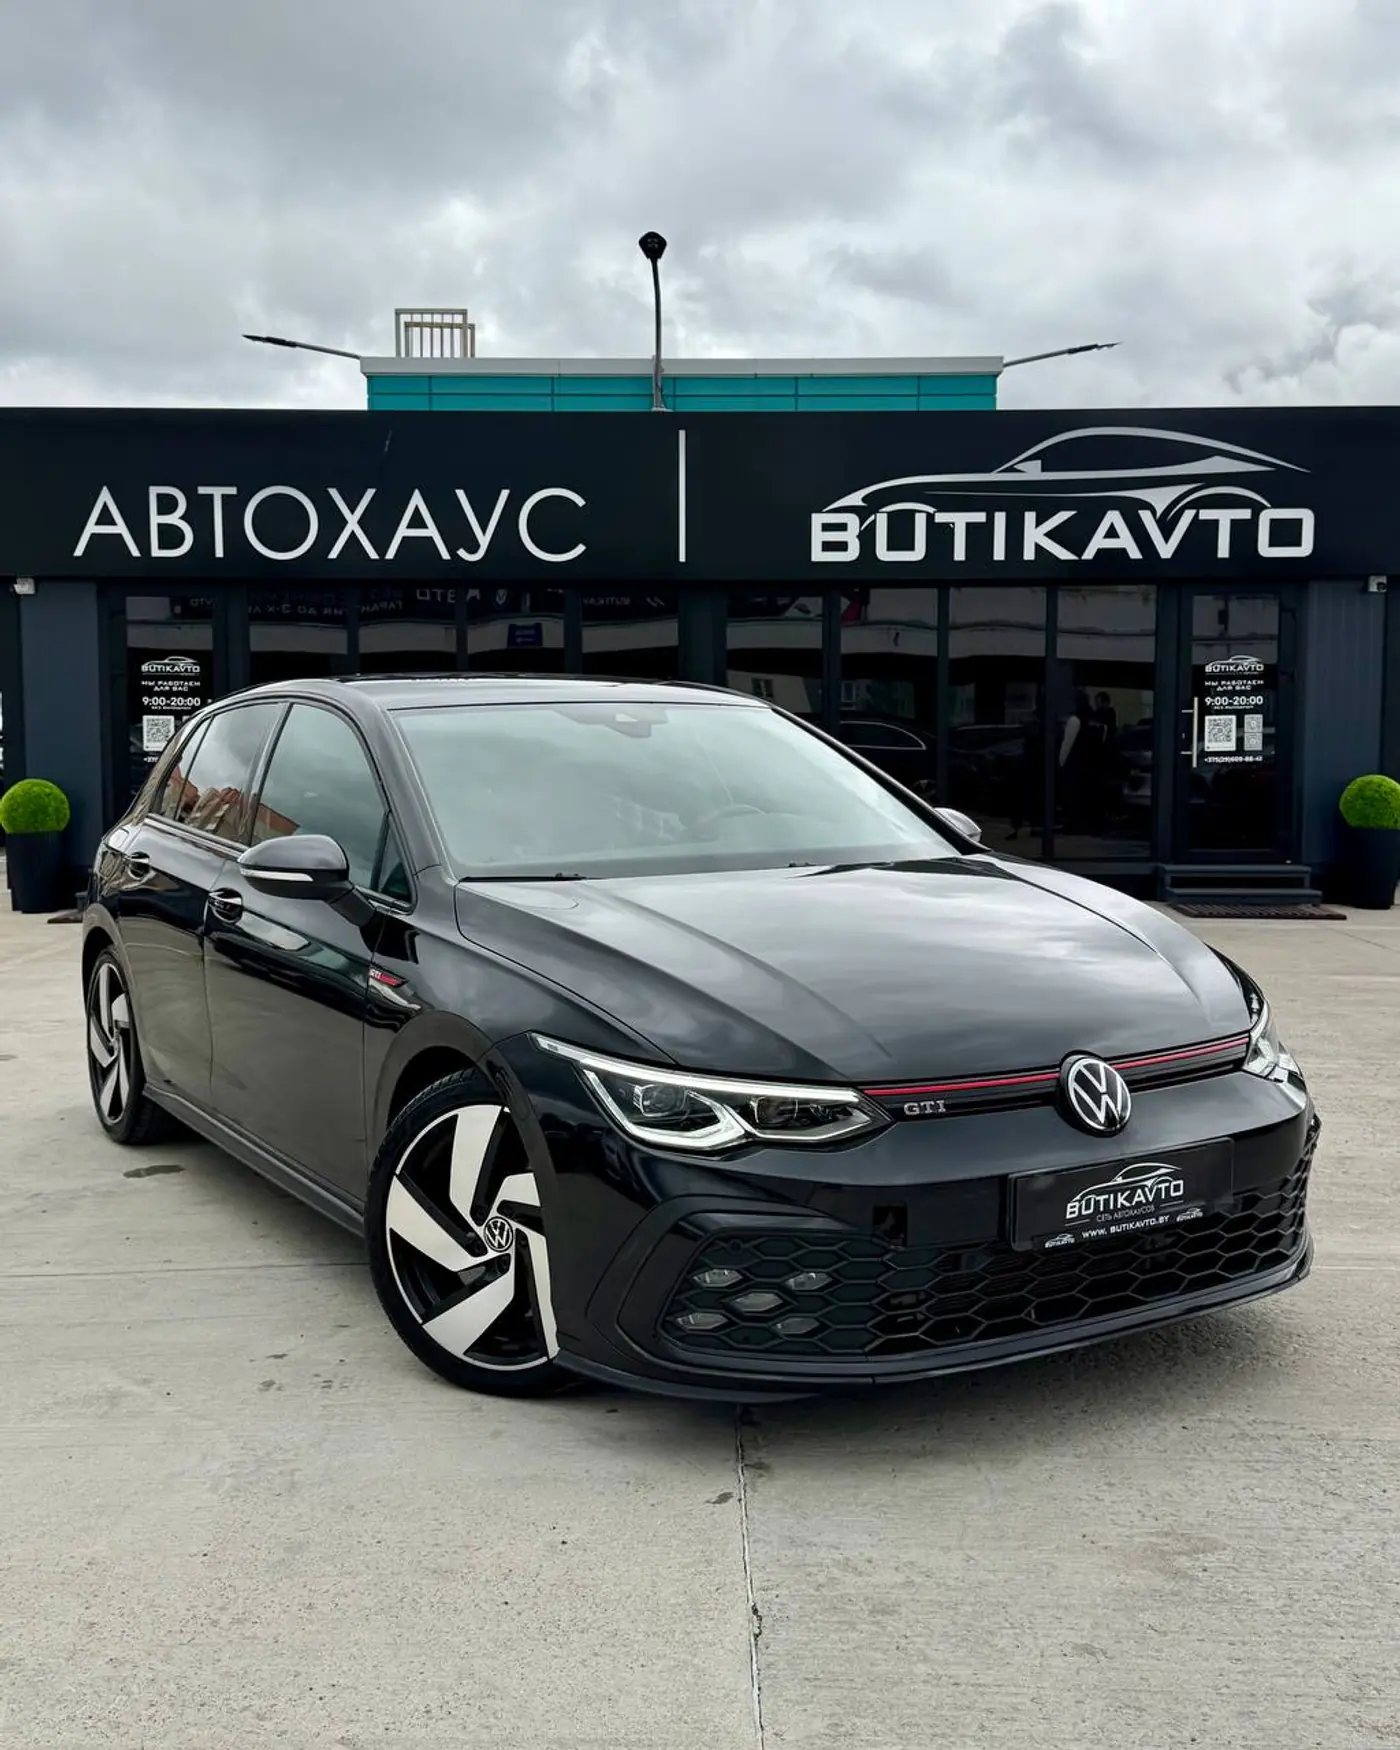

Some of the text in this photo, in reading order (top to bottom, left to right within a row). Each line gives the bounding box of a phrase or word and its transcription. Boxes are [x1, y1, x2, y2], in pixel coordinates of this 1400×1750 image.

[73, 485, 588, 562] АВТОХАУС
[811, 508, 1315, 562] BUTIKAVTO
[141, 664, 200, 673] BUTIKAVTO
[1204, 663, 1264, 673] BUTIKAVTO
[142, 696, 201, 706] 9:00-20:00
[1204, 696, 1263, 706] 9:00-20:00
[903, 1100, 947, 1116] GTI
[1065, 1179, 1184, 1219] BUTIKAVTO
